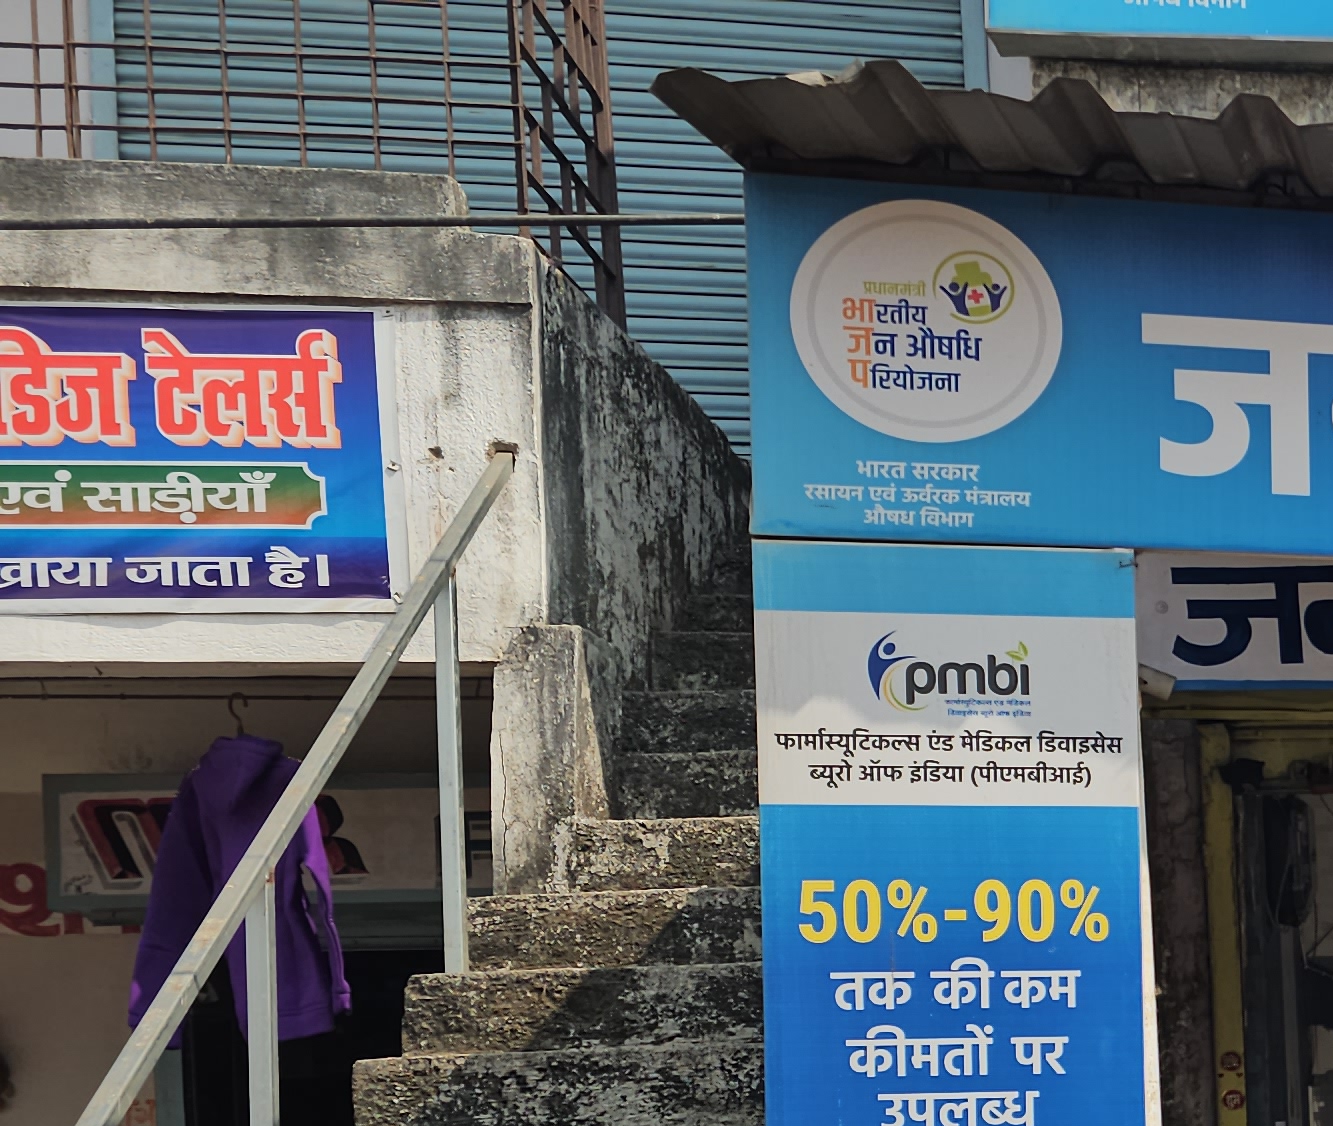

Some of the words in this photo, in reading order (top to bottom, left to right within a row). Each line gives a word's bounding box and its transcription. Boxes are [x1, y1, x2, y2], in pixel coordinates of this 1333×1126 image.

[863, 280, 927, 297] प्रधानमंत्री
[842, 296, 928, 327] भारतीय
[842, 325, 898, 358] जन
[905, 327, 983, 361] औषधि
[141, 328, 342, 449] टेलर्स
[847, 358, 961, 393] परियोजना
[857, 460, 906, 480] भारत
[912, 462, 980, 482] सरकार
[0, 469, 72, 515] एवं
[80, 471, 277, 524] साड़ीयाँ
[804, 483, 863, 502] रसायन
[869, 483, 896, 503] एवं
[964, 487, 1031, 508] मंत्रालय
[863, 504, 914, 527] औषध
[920, 509, 974, 528] विभाग
[124, 557, 253, 588] जाता
[905, 654, 1030, 705] pmbi
[774, 728, 921, 757] फार्मास्यूटिकल्स
[927, 729, 954, 752] एंड
[961, 730, 1032, 753] मेडिकल
[1037, 731, 1123, 755] डिवाइसेस
[808, 760, 852, 788] ब्यूरो
[859, 760, 903, 783] ऑफ
[909, 760, 964, 784] इंडिया
[970, 761, 1092, 788] (पीएमबीआई)
[798, 878, 1110, 944] 50%-90%
[829, 969, 915, 1011] तक
[929, 956, 995, 1010] की
[1000, 969, 1082, 1009] कम
[845, 1023, 994, 1078] कीमतों
[1010, 1035, 1069, 1075] पर
